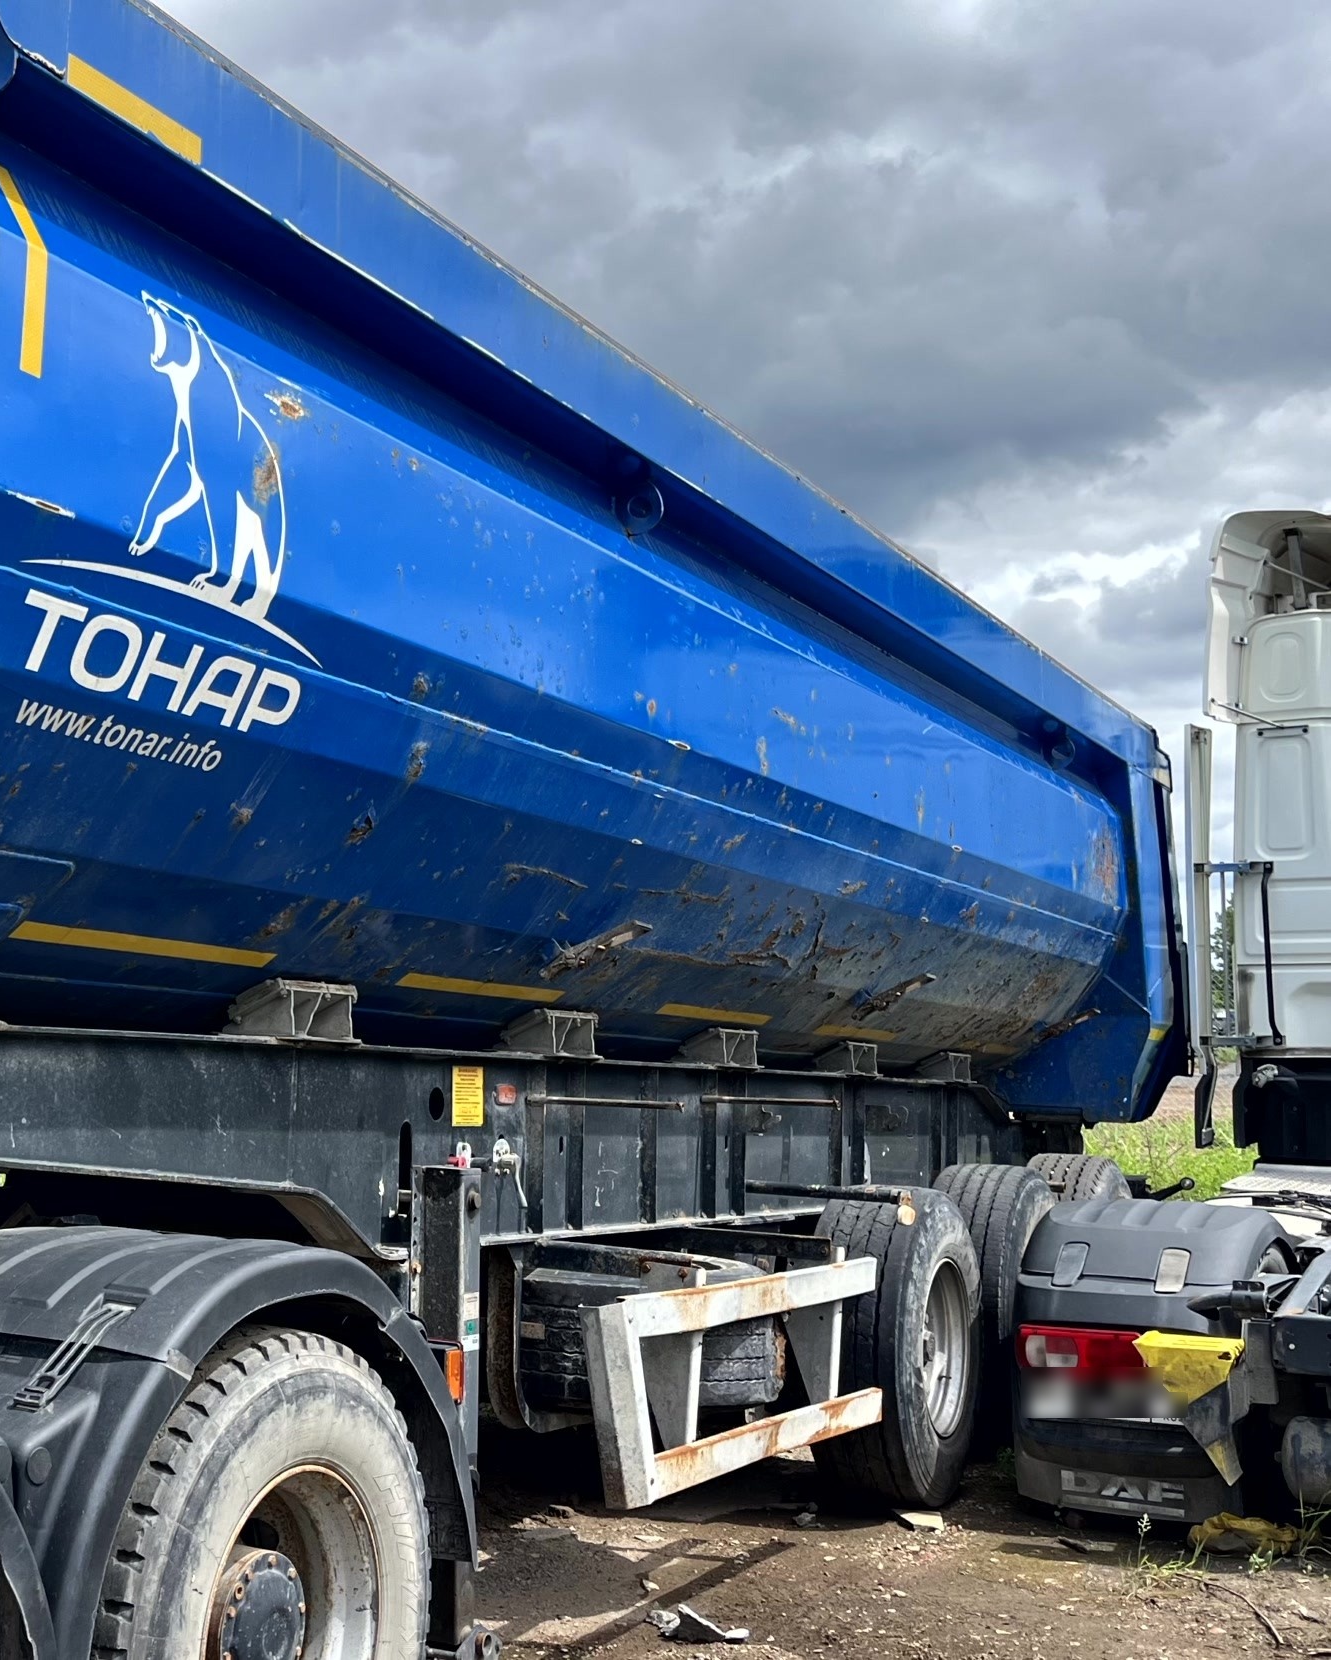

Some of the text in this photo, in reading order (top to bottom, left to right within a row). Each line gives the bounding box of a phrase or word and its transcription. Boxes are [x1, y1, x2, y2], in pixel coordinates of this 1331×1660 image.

[24, 588, 301, 732] ТОНАР
[15, 698, 222, 772] www.tonar.info
[1060, 1469, 1185, 1502] DAF
